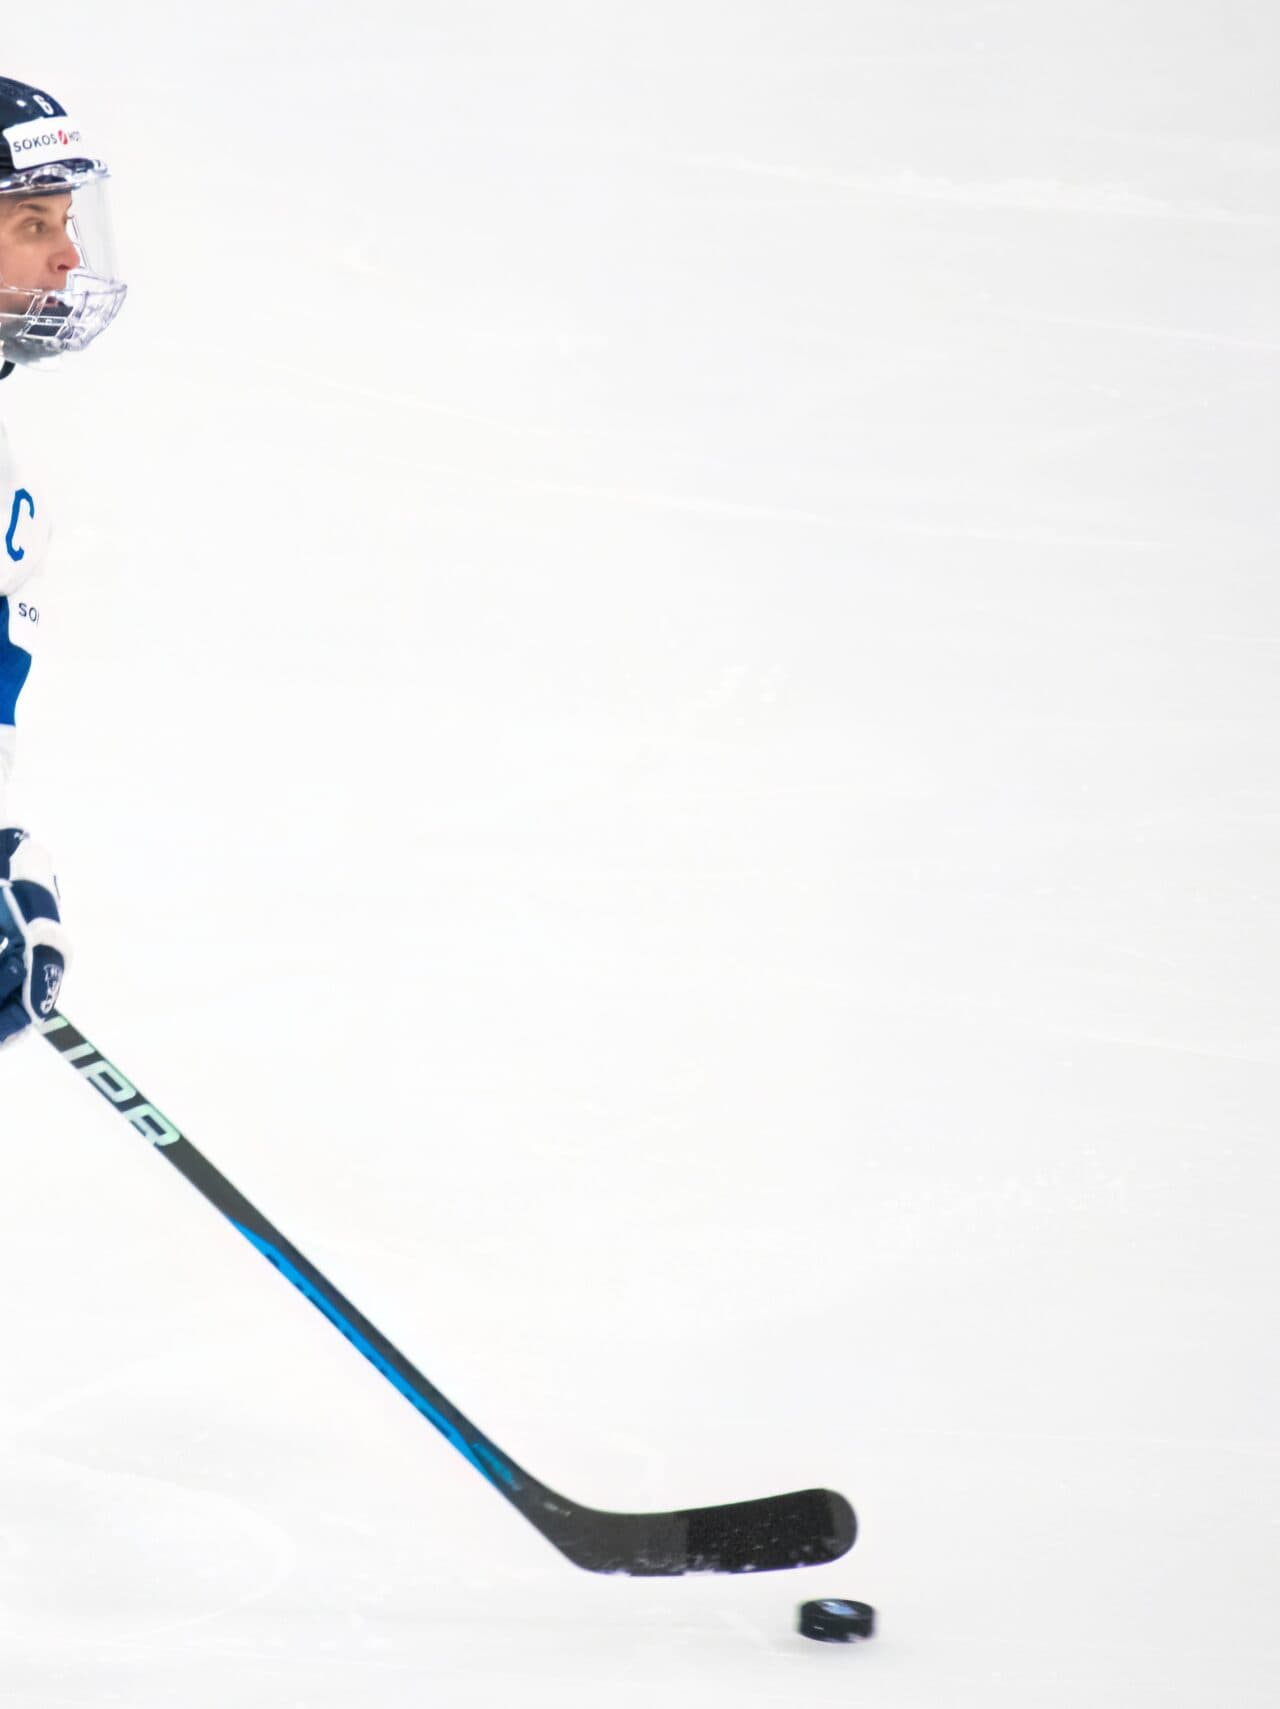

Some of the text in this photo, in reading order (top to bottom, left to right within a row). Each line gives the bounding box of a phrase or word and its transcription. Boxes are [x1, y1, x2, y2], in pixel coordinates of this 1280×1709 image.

[13, 133, 58, 153] SOKOS
[5, 488, 35, 562] C
[18, 602, 40, 624] SO
